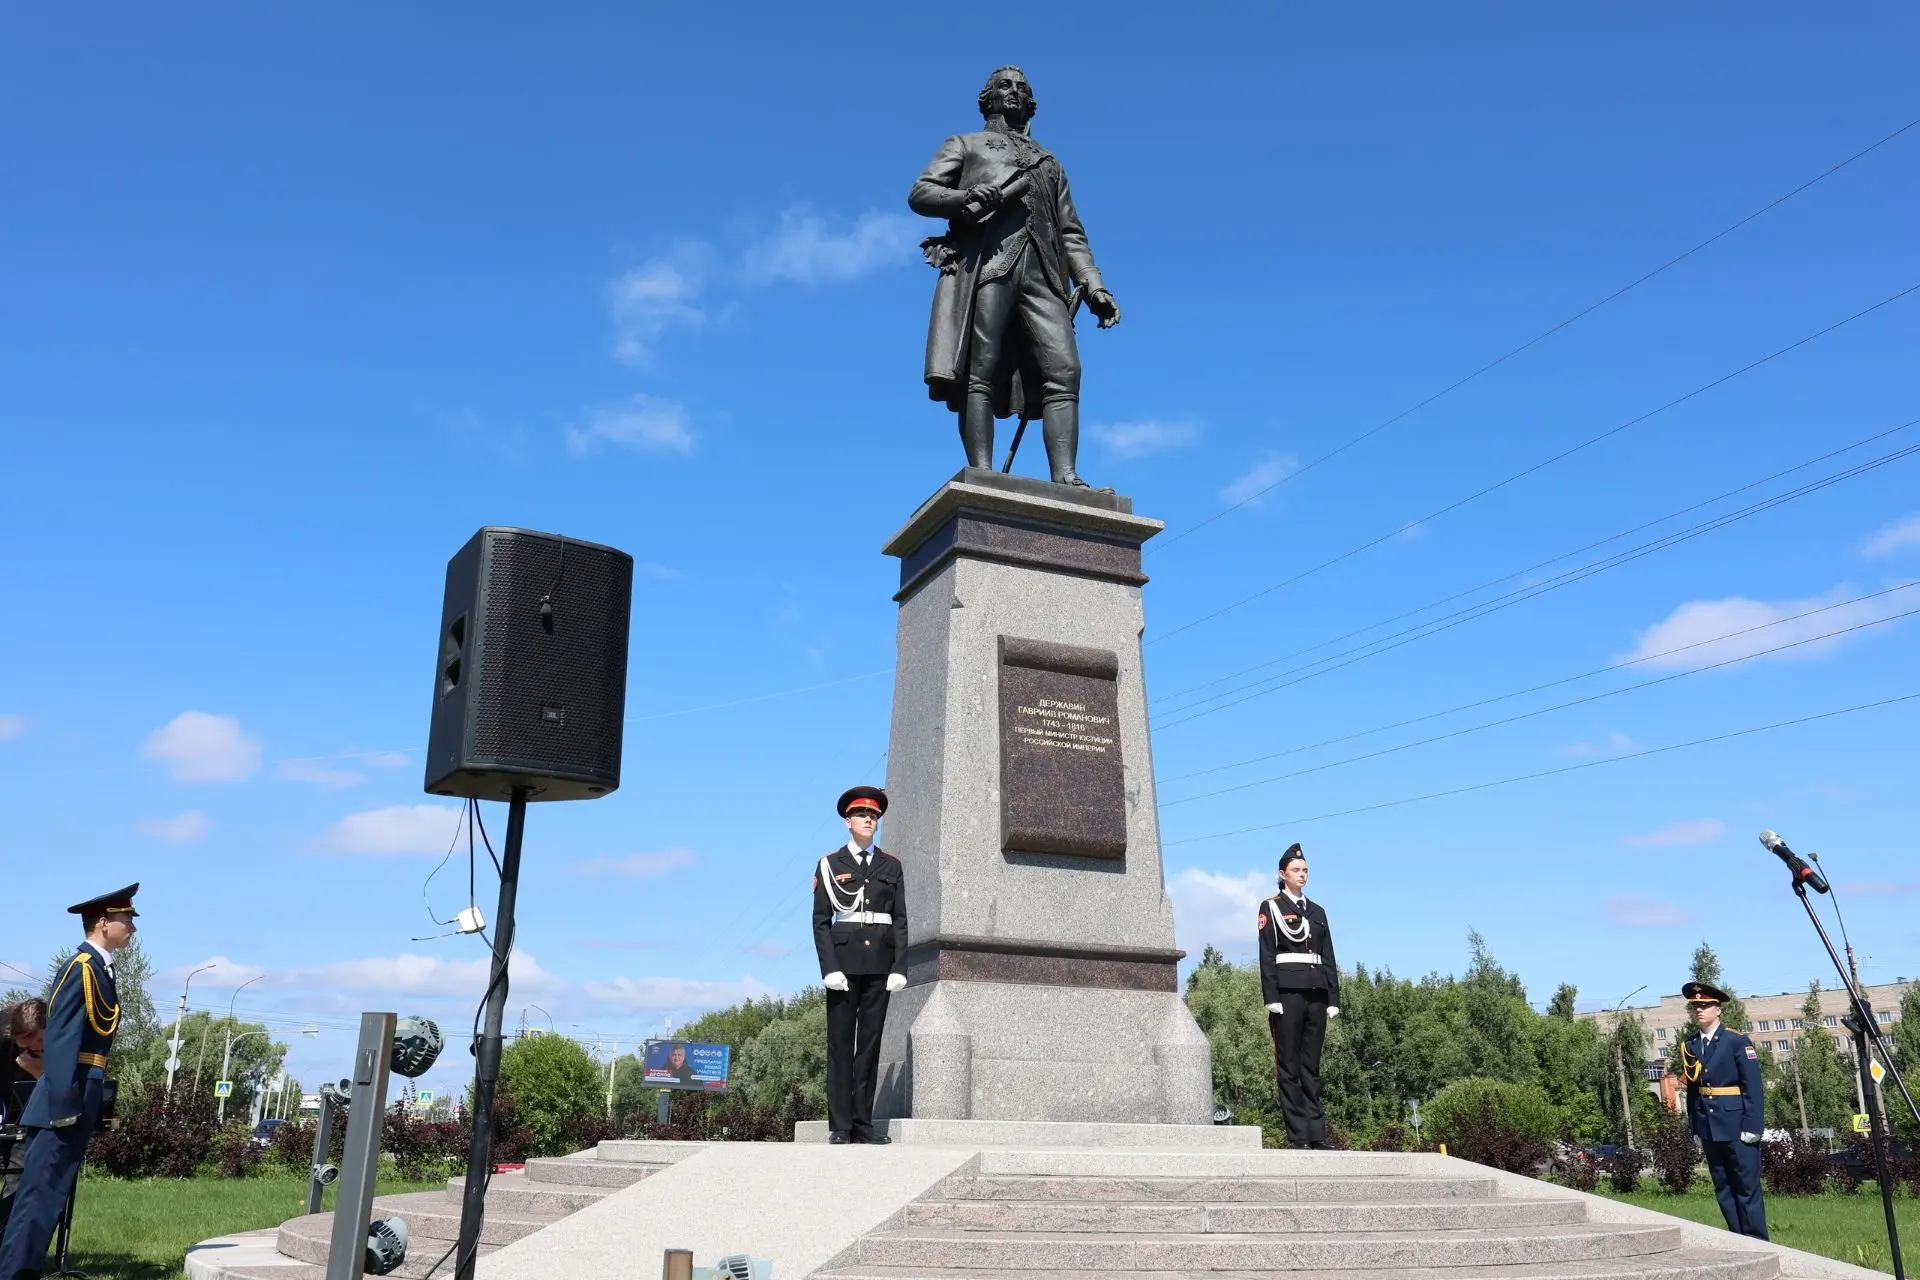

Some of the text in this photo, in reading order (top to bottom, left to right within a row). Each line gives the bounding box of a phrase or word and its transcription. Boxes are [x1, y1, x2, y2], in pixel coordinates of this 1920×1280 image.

[1039, 698, 1086, 712] ДЕРЖАВИН
[1017, 705, 1110, 725] ГАВРИИЛ РОМАНОВИЧ
[1042, 719, 1060, 728] 1743
[1067, 722, 1086, 731] 1816
[1014, 726, 1113, 745] ПЕРВЫЙ МИНИСТР ЮСТИЦИИ
[1024, 737, 1106, 753] РОССИЙСКОЙ ИМПЕРИИ
